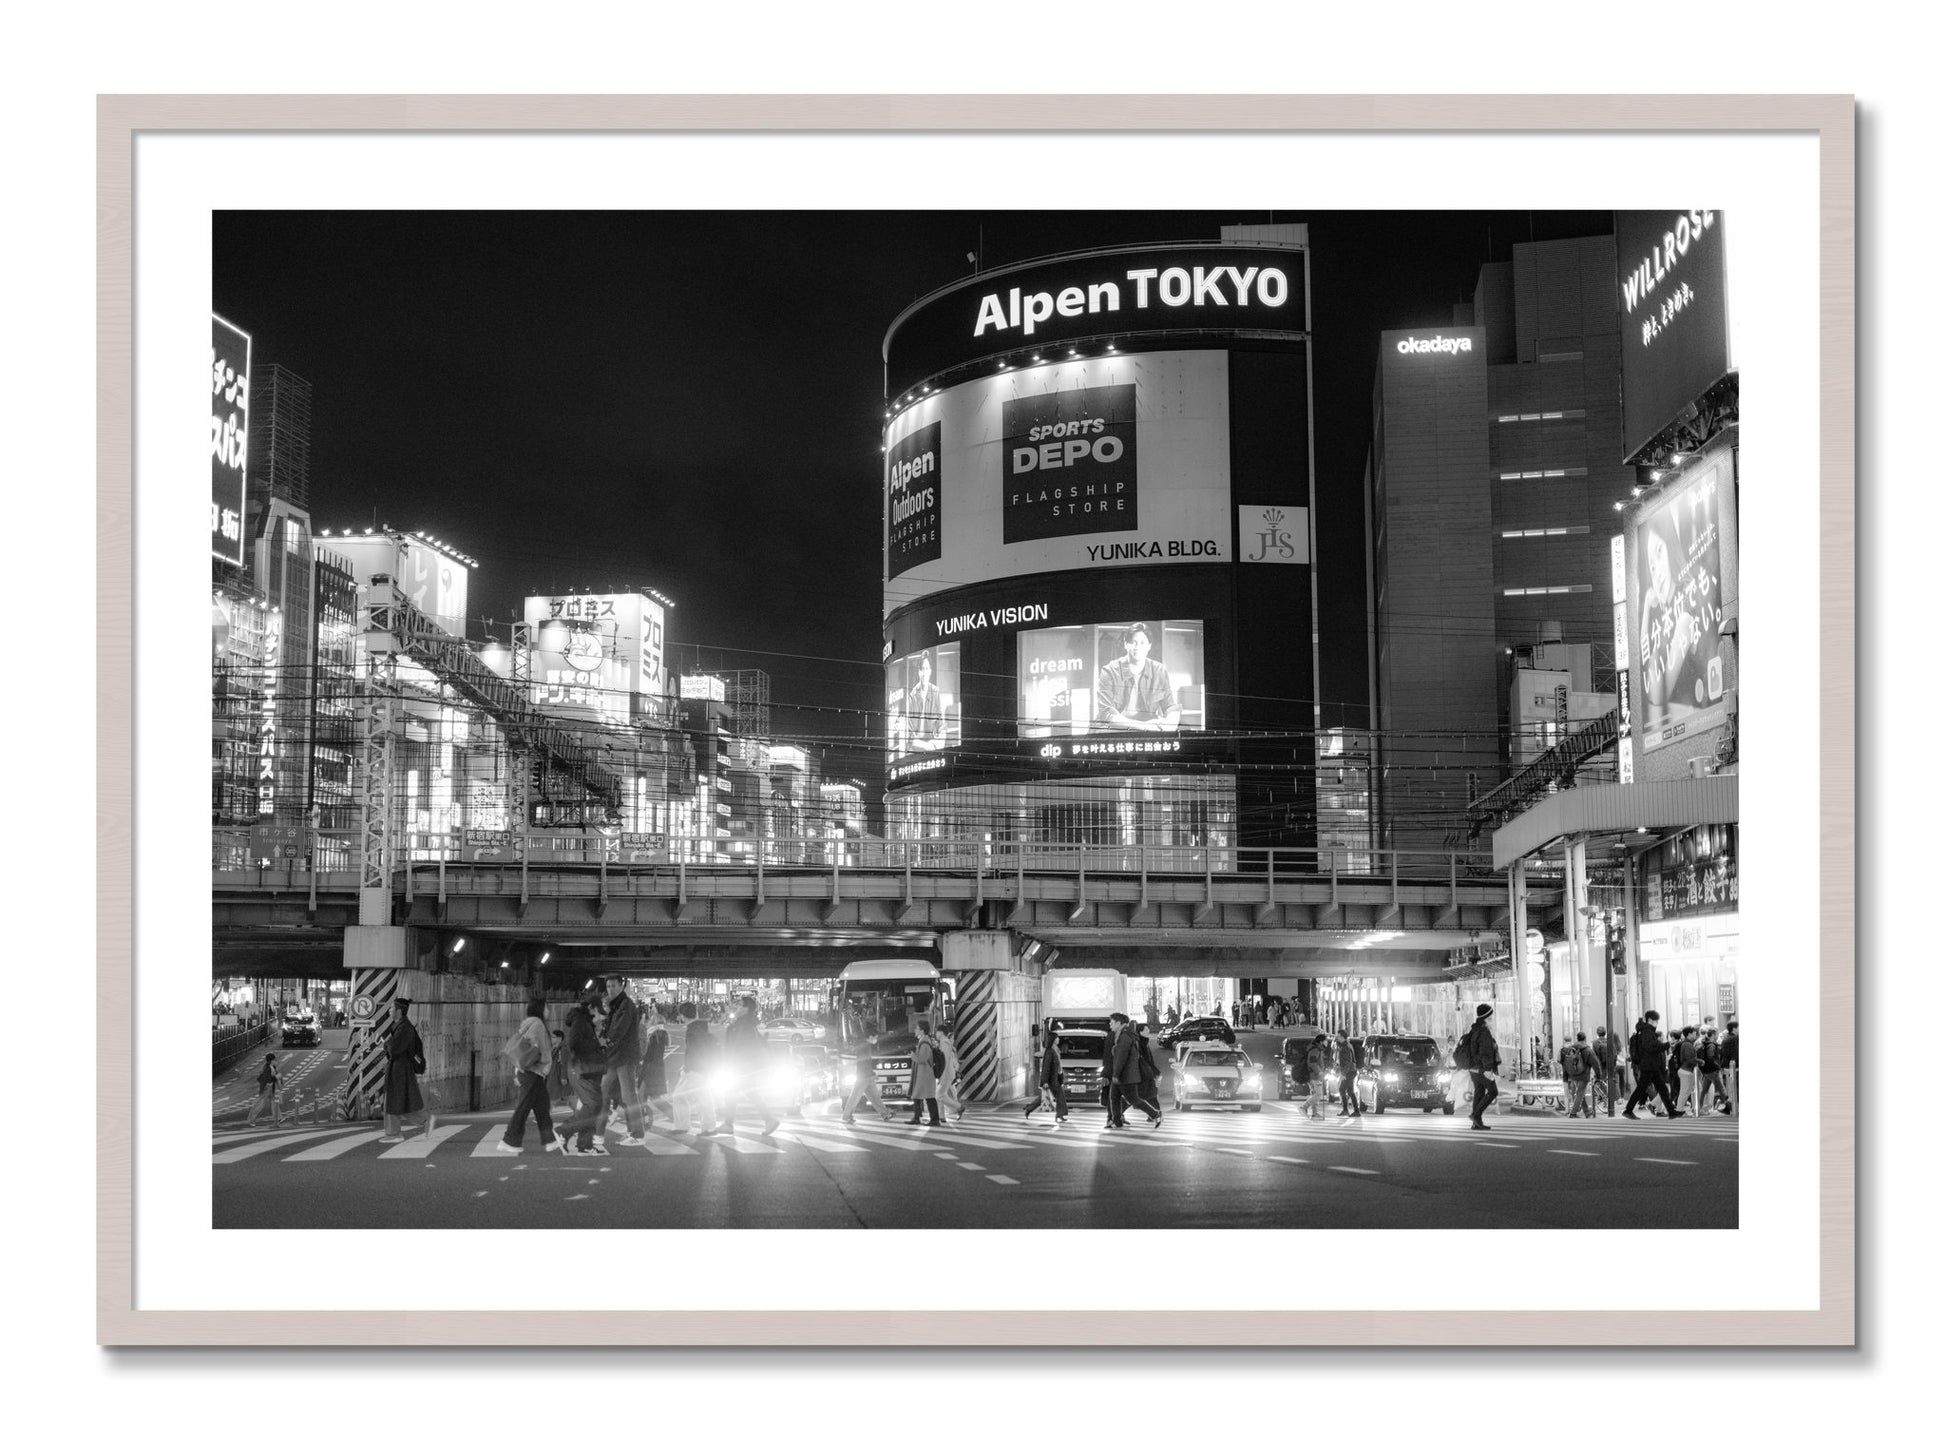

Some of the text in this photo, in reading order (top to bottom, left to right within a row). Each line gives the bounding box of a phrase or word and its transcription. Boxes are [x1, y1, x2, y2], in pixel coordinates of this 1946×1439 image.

[973, 266, 1288, 337] Alpen TOKYO
[1397, 335, 1472, 355] okadaya
[212, 347, 247, 409] チンコ
[1028, 418, 1105, 442] SPORTS
[1013, 436, 1124, 474] DEPO
[890, 451, 935, 495] Alpen
[1013, 482, 1124, 505] FLAGSHIP
[893, 487, 934, 526] Outdoors
[1053, 500, 1124, 516] STORE
[890, 514, 935, 546] FLAGSHIP
[903, 530, 935, 553] STORE
[1087, 540, 1221, 561] YUNIKA BLDG.
[324, 603, 351, 624] SHISHA
[550, 598, 616, 618] プロミス
[936, 604, 1048, 637] YUNIKA VISION
[1030, 658, 1083, 674] dream
[1040, 741, 1180, 758] dip 夢を叶える仕事に出会おう
